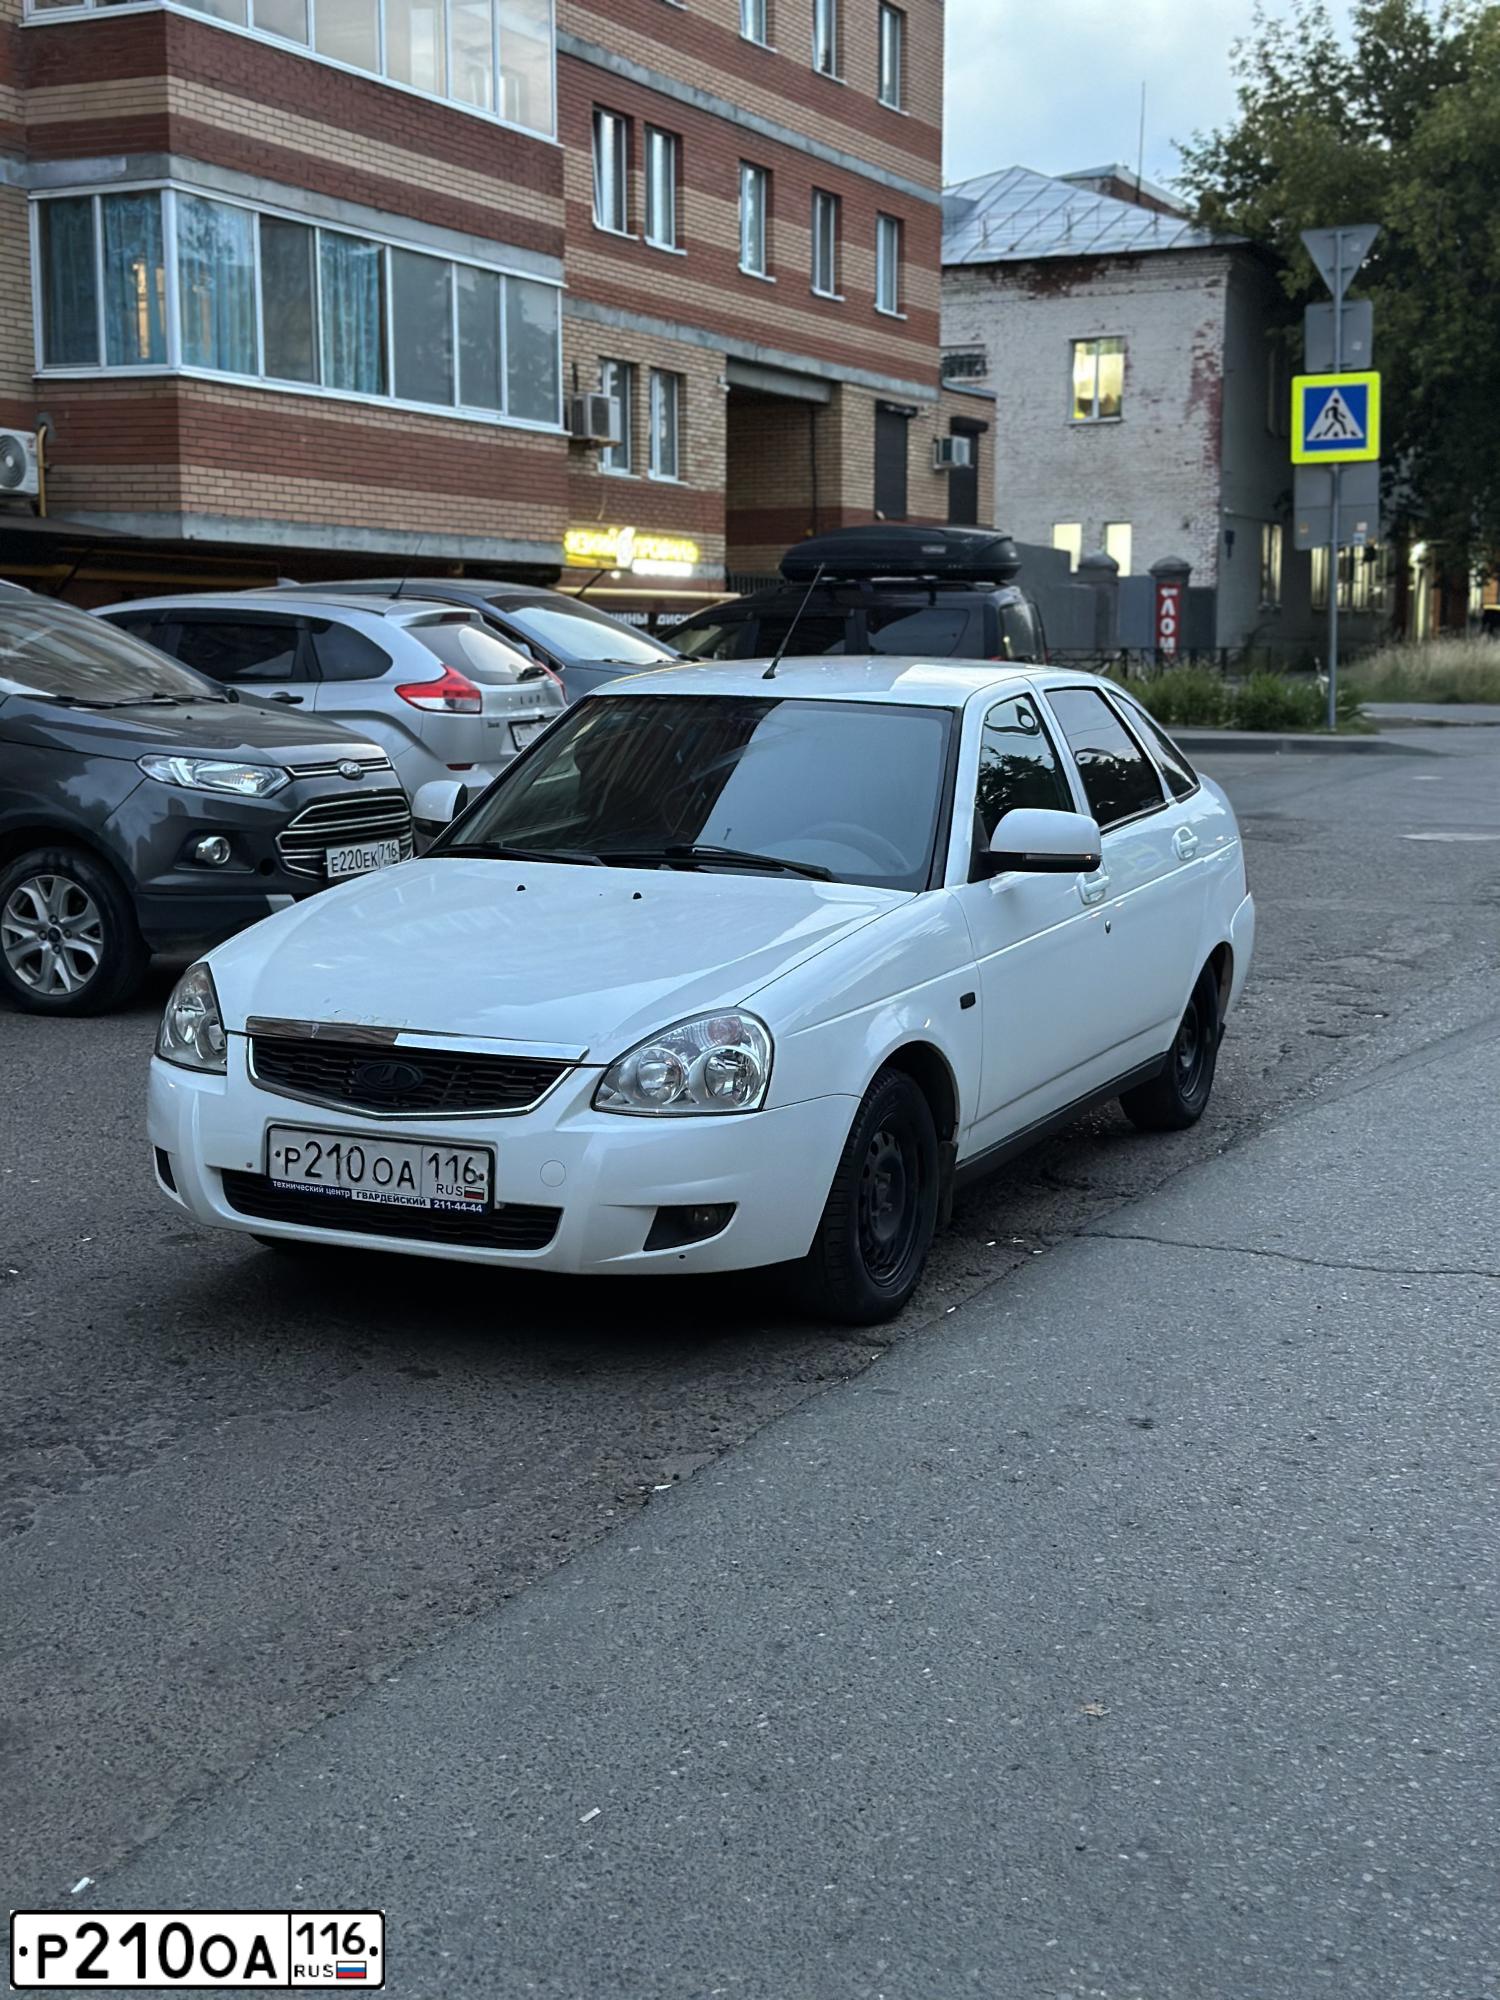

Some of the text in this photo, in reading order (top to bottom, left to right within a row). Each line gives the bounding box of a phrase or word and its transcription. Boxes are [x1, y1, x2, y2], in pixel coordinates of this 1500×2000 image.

[427, 1152, 479, 1185] 116
[325, 1187, 351, 1199] центр
[356, 1190, 427, 1207] ГВАРДЕЙСКИЙ
[433, 1199, 483, 1213] 211-44-44
[436, 1183, 464, 1197] RUS
